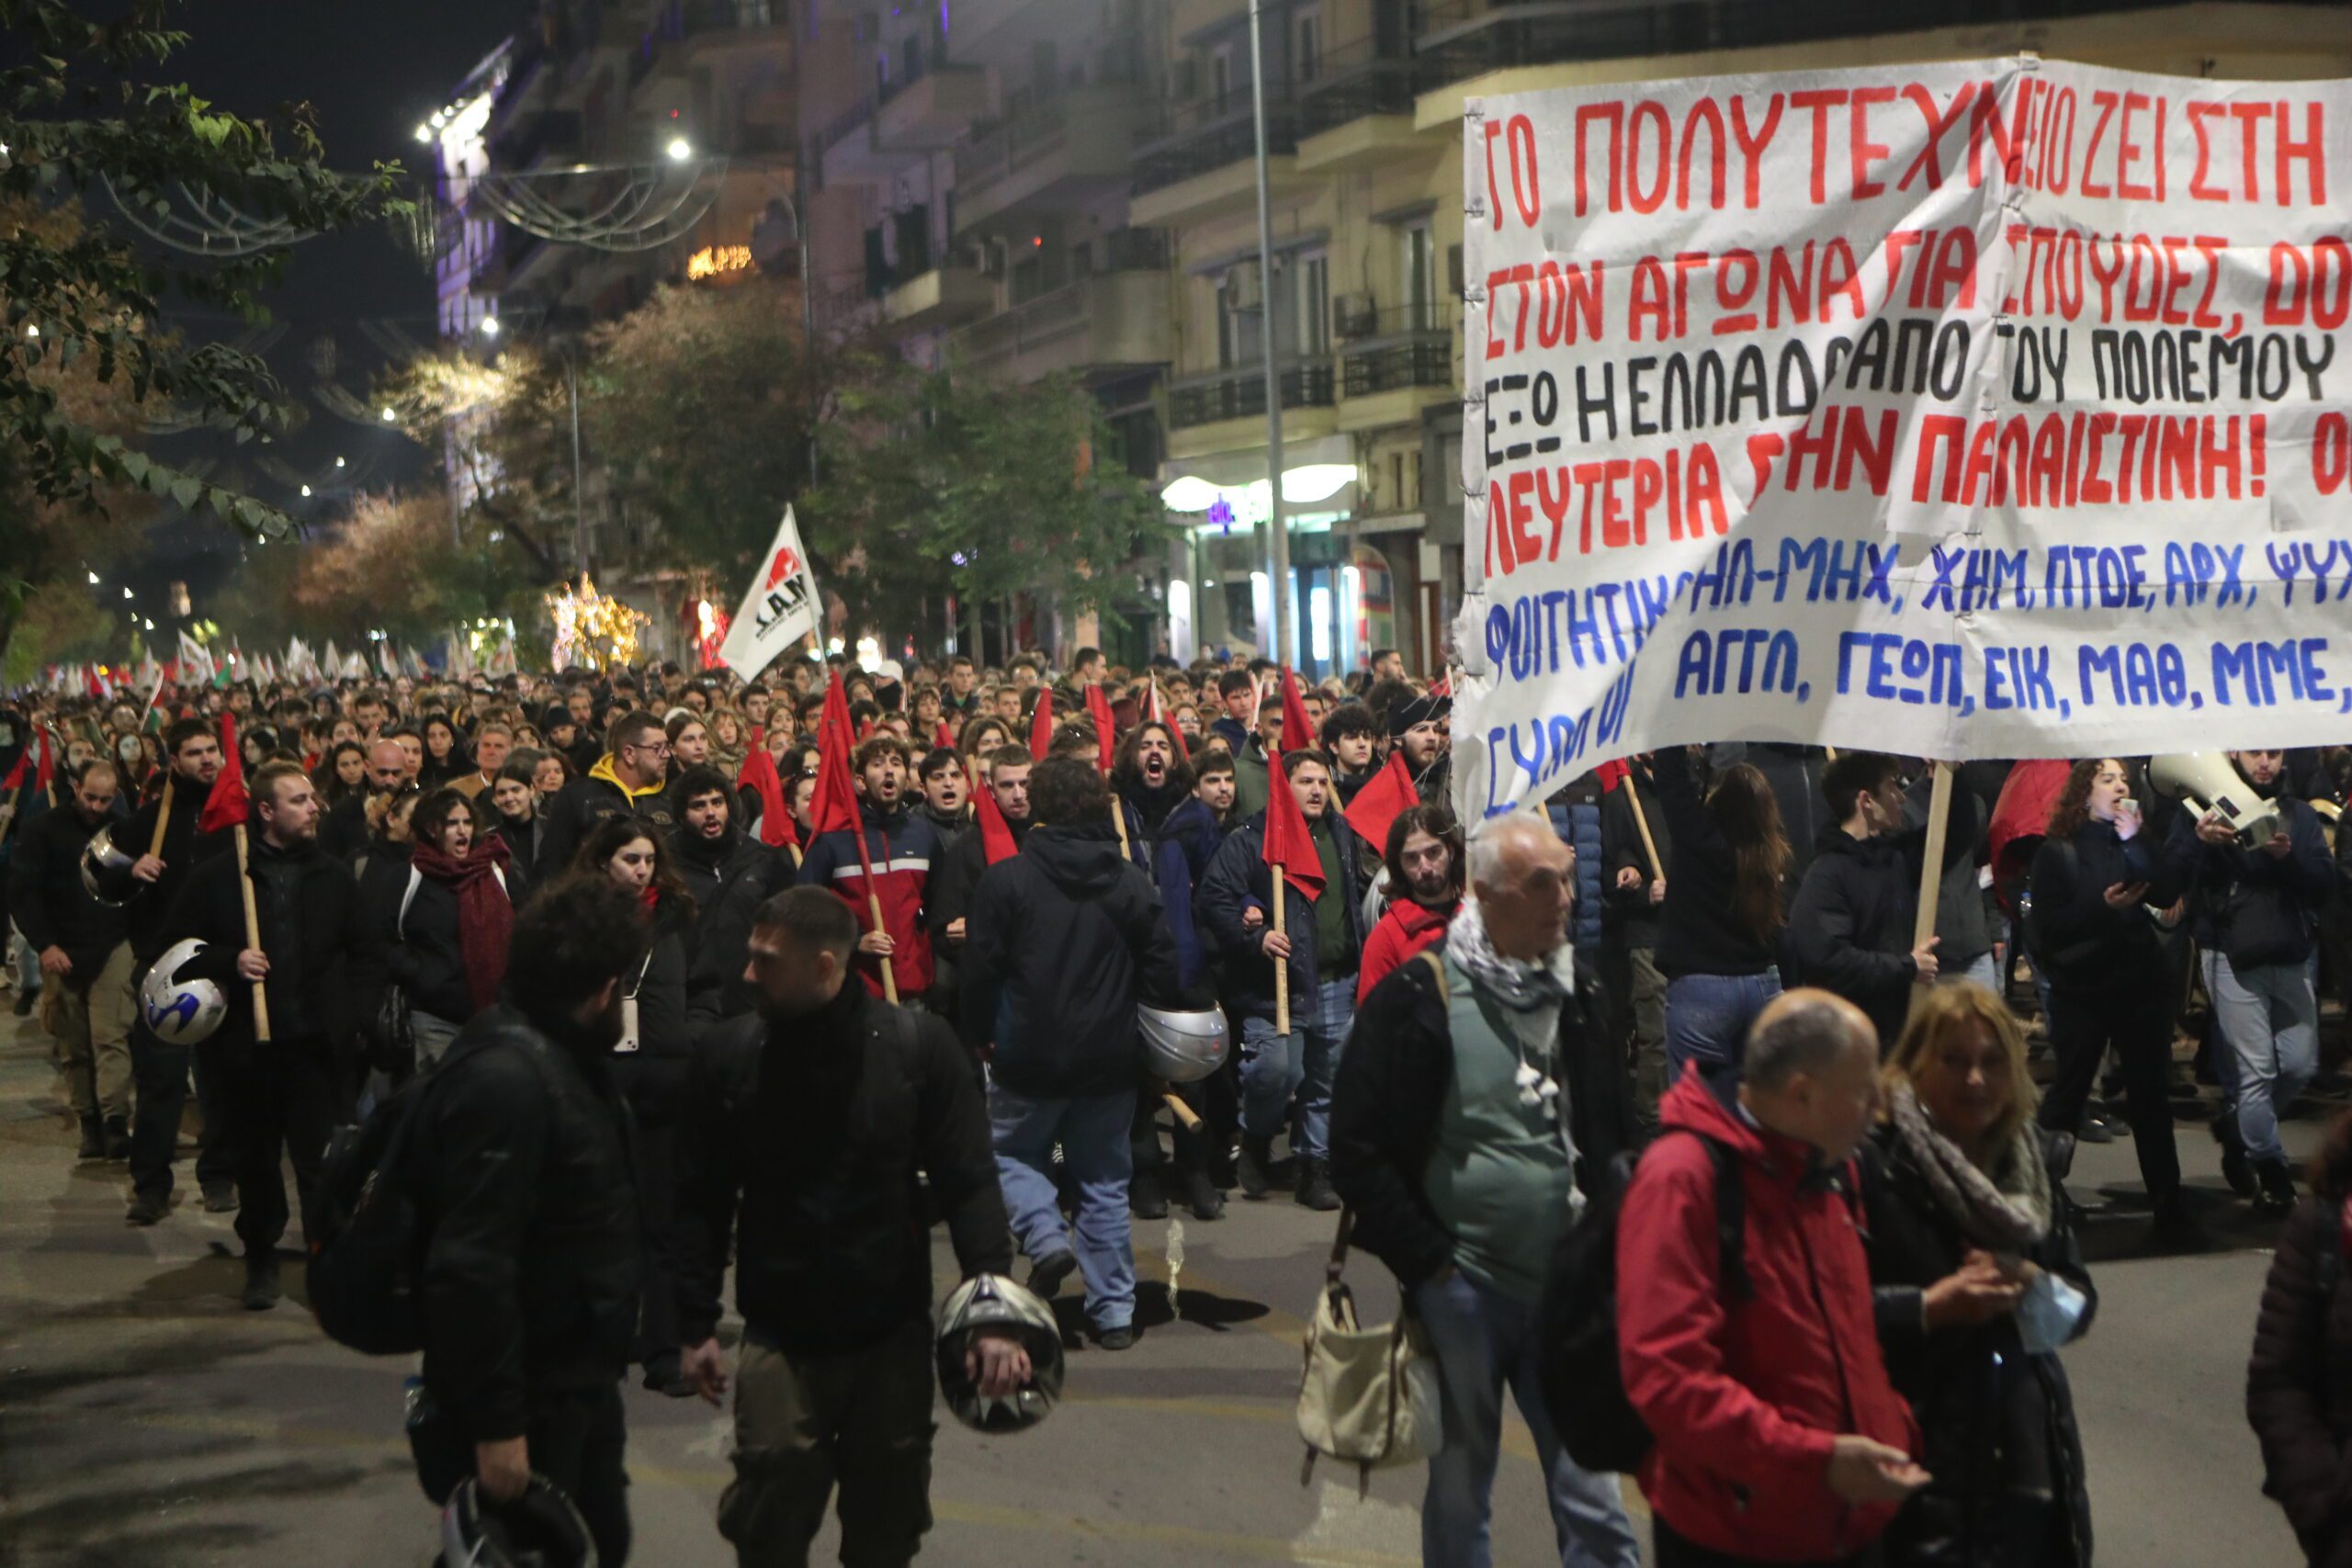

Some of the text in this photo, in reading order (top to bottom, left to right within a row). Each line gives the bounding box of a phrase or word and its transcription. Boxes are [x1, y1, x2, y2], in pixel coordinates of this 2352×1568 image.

[1574, 77, 2076, 218] ΠΟΛΥΤΕΧΝΕΙΟ
[2081, 89, 2166, 203] ΖΕΙ
[2187, 99, 2326, 206] ΣΤΗ
[1486, 260, 1604, 360] ΣΤΟΝ
[1628, 237, 1866, 343] ΑΓΩΝΑ
[1881, 226, 1978, 310] ΓΙΑ
[1485, 370, 1561, 469] ΕΞΩ
[1845, 318, 1971, 401] ΑΠΟ
[2091, 329, 2335, 404] ΠΟΛΕΜΟΥ
[1485, 405, 2352, 579] ΛΕΥΤΕΡΙΑ ΣΗΝ ΠΑΛΑΙΣΤΙΝΗ! Ο
[1921, 543, 2036, 612] ΧΗΜ,
[2165, 541, 2257, 610] ΑΡΧ,
[1984, 645, 2071, 721] ΕΙΚ,
[2078, 642, 2204, 712] ΜΑΘ,
[2211, 637, 2352, 714] ΜΜΕ,
